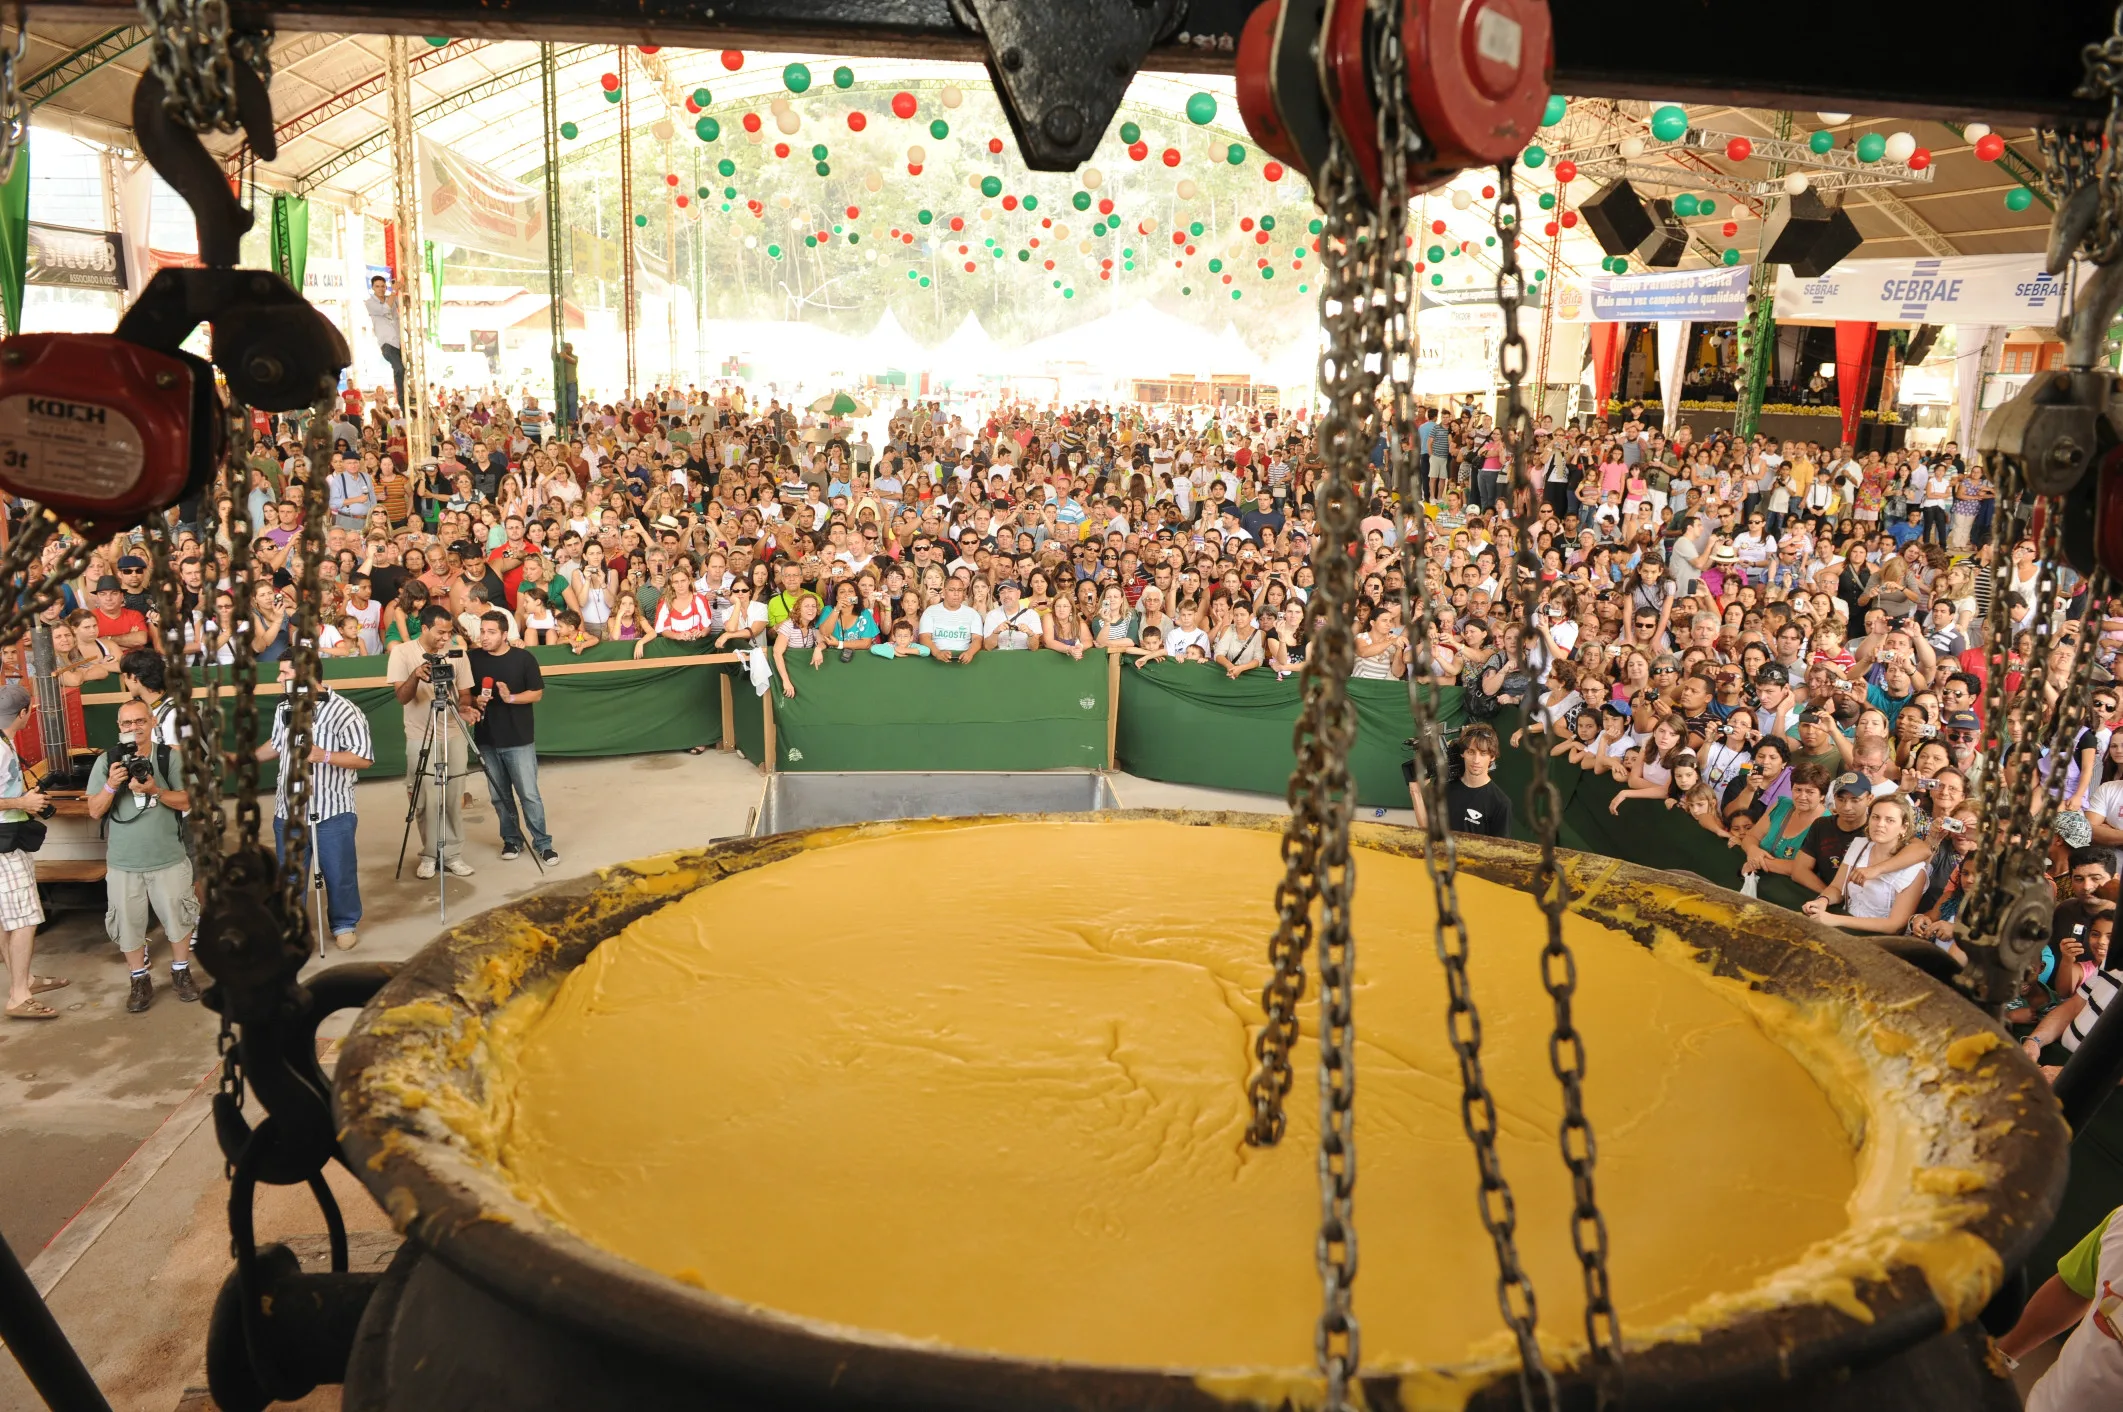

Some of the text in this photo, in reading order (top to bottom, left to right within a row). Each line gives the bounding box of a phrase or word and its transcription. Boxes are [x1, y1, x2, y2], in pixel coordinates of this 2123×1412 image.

[323, 274, 343, 287] CAIXA
[1596, 290, 1746, 307] Mais uma vez campeão de qualidade
[1803, 279, 2068, 301] SEBRAE SEBRAE SEBRAE
[28, 397, 106, 425] KOCH
[934, 629, 968, 639] LACOSTE
